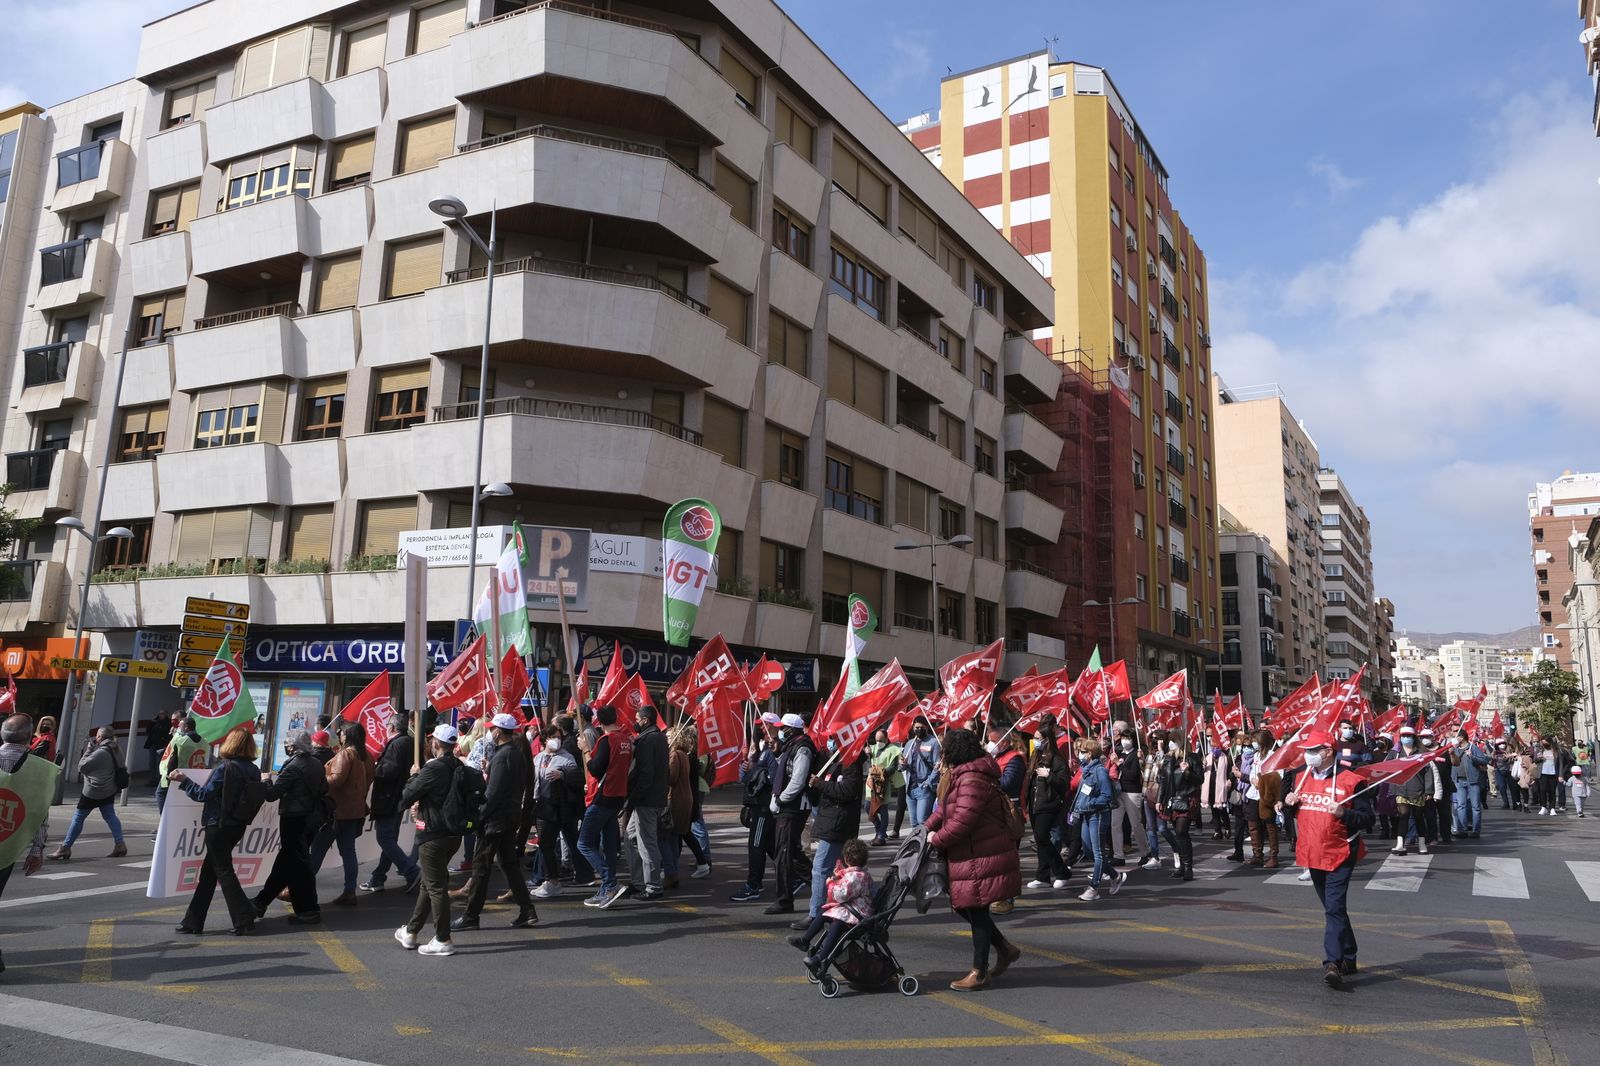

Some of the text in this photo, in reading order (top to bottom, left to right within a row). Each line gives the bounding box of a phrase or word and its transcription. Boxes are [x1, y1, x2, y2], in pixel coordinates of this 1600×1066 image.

[449, 533, 495, 541] IMPLANTLOGÍA
[425, 544, 450, 552] ESTÉTICA
[590, 539, 632, 556] AGUT
[589, 556, 637, 567] SEÑO DENTAL
[528, 580, 543, 593] 24
[545, 581, 577, 594] hoas
[670, 617, 689, 630] lucía
[141, 632, 173, 642] OPTICA
[347, 639, 450, 664] ORBA
[138, 665, 164, 674] Rambla
[206, 663, 237, 707] UGT
